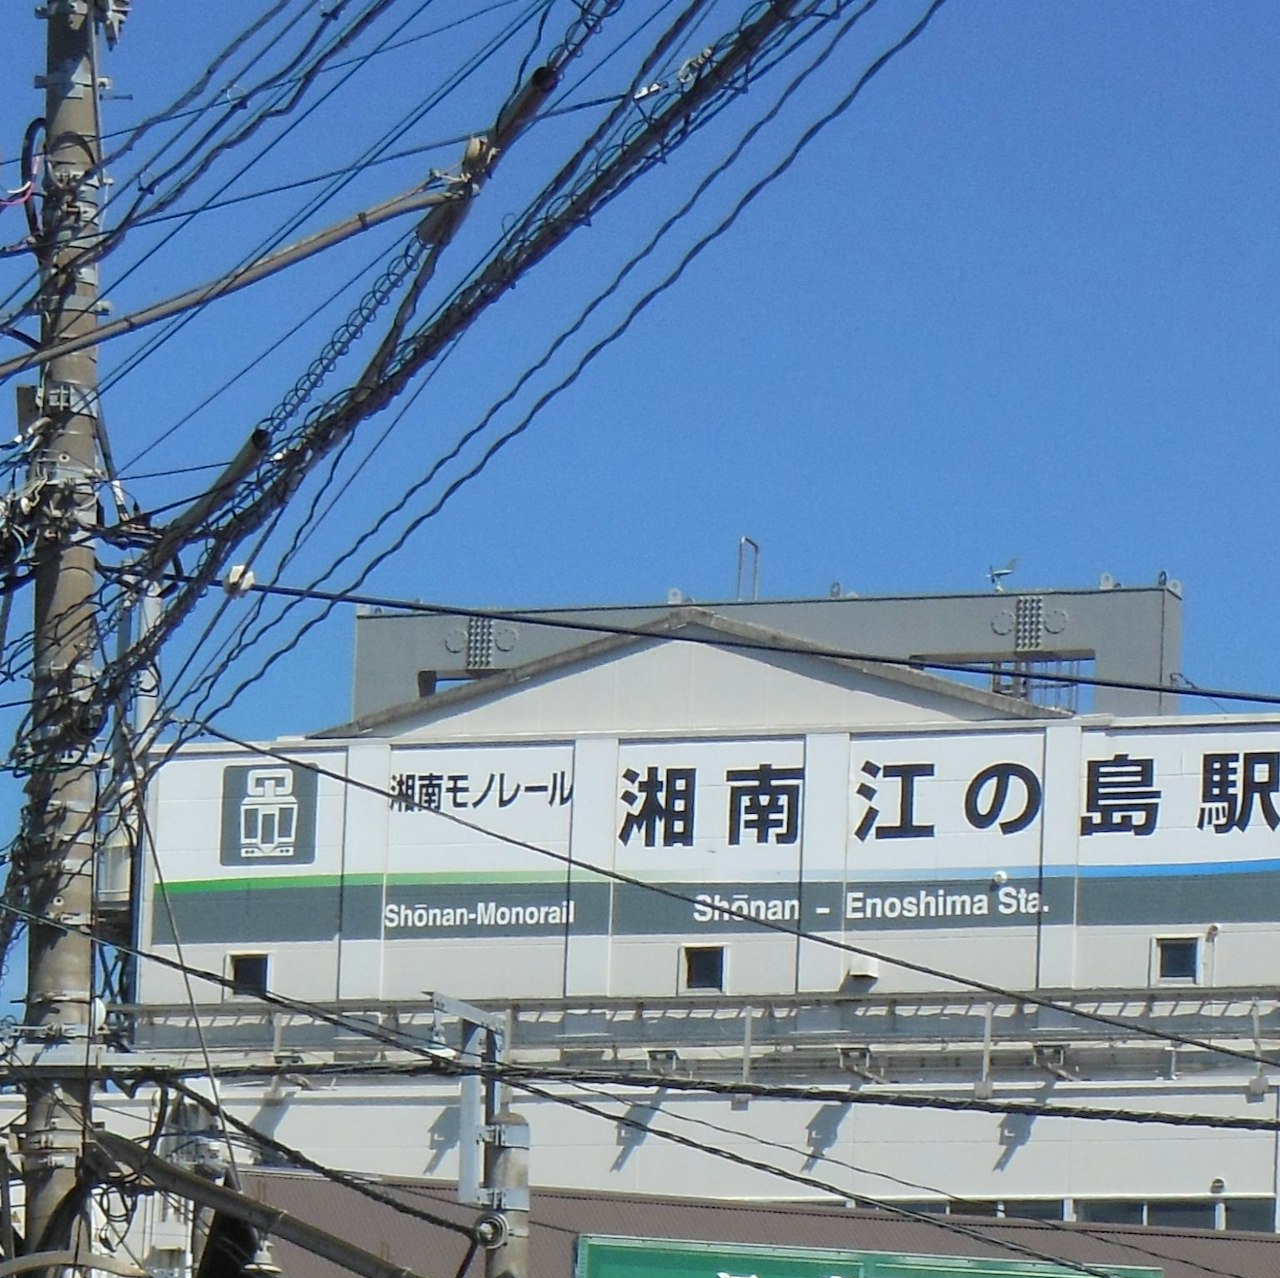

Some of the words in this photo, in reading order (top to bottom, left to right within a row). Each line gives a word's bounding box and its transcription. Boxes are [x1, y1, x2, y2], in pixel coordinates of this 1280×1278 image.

[389, 771, 575, 813] 湘南モノレール
[845, 889, 989, 919] Enoshima
[997, 887, 1050, 915] Sta.
